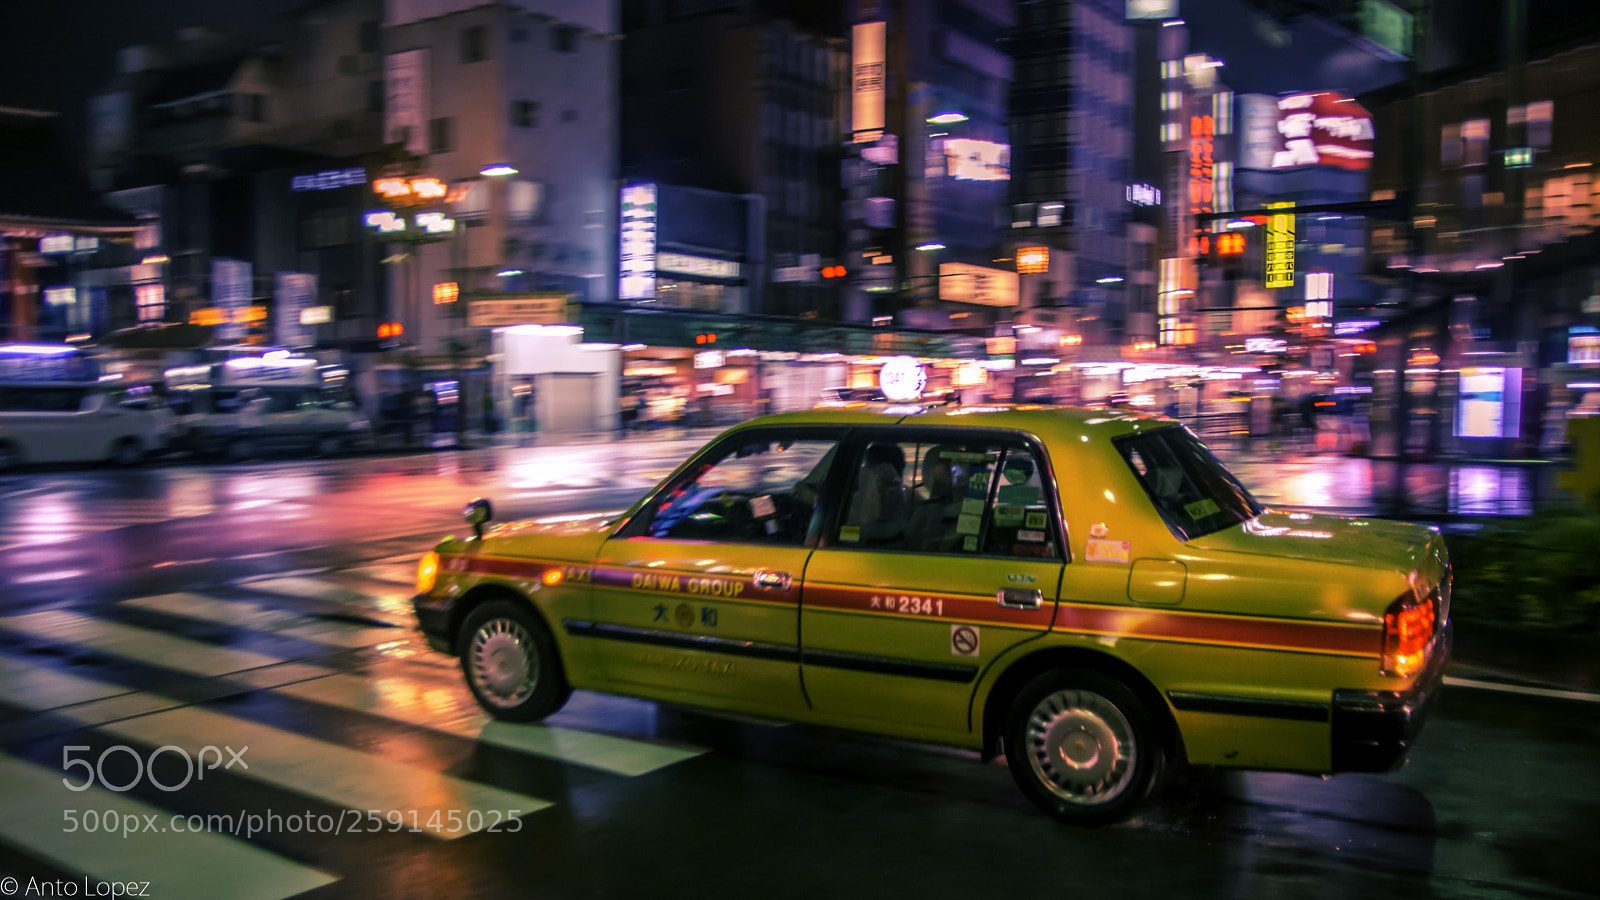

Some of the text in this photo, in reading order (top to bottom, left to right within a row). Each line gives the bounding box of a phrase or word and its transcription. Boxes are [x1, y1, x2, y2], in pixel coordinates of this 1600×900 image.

[632, 572, 744, 597] DAIWA GROUP
[899, 597, 943, 617] 2341
